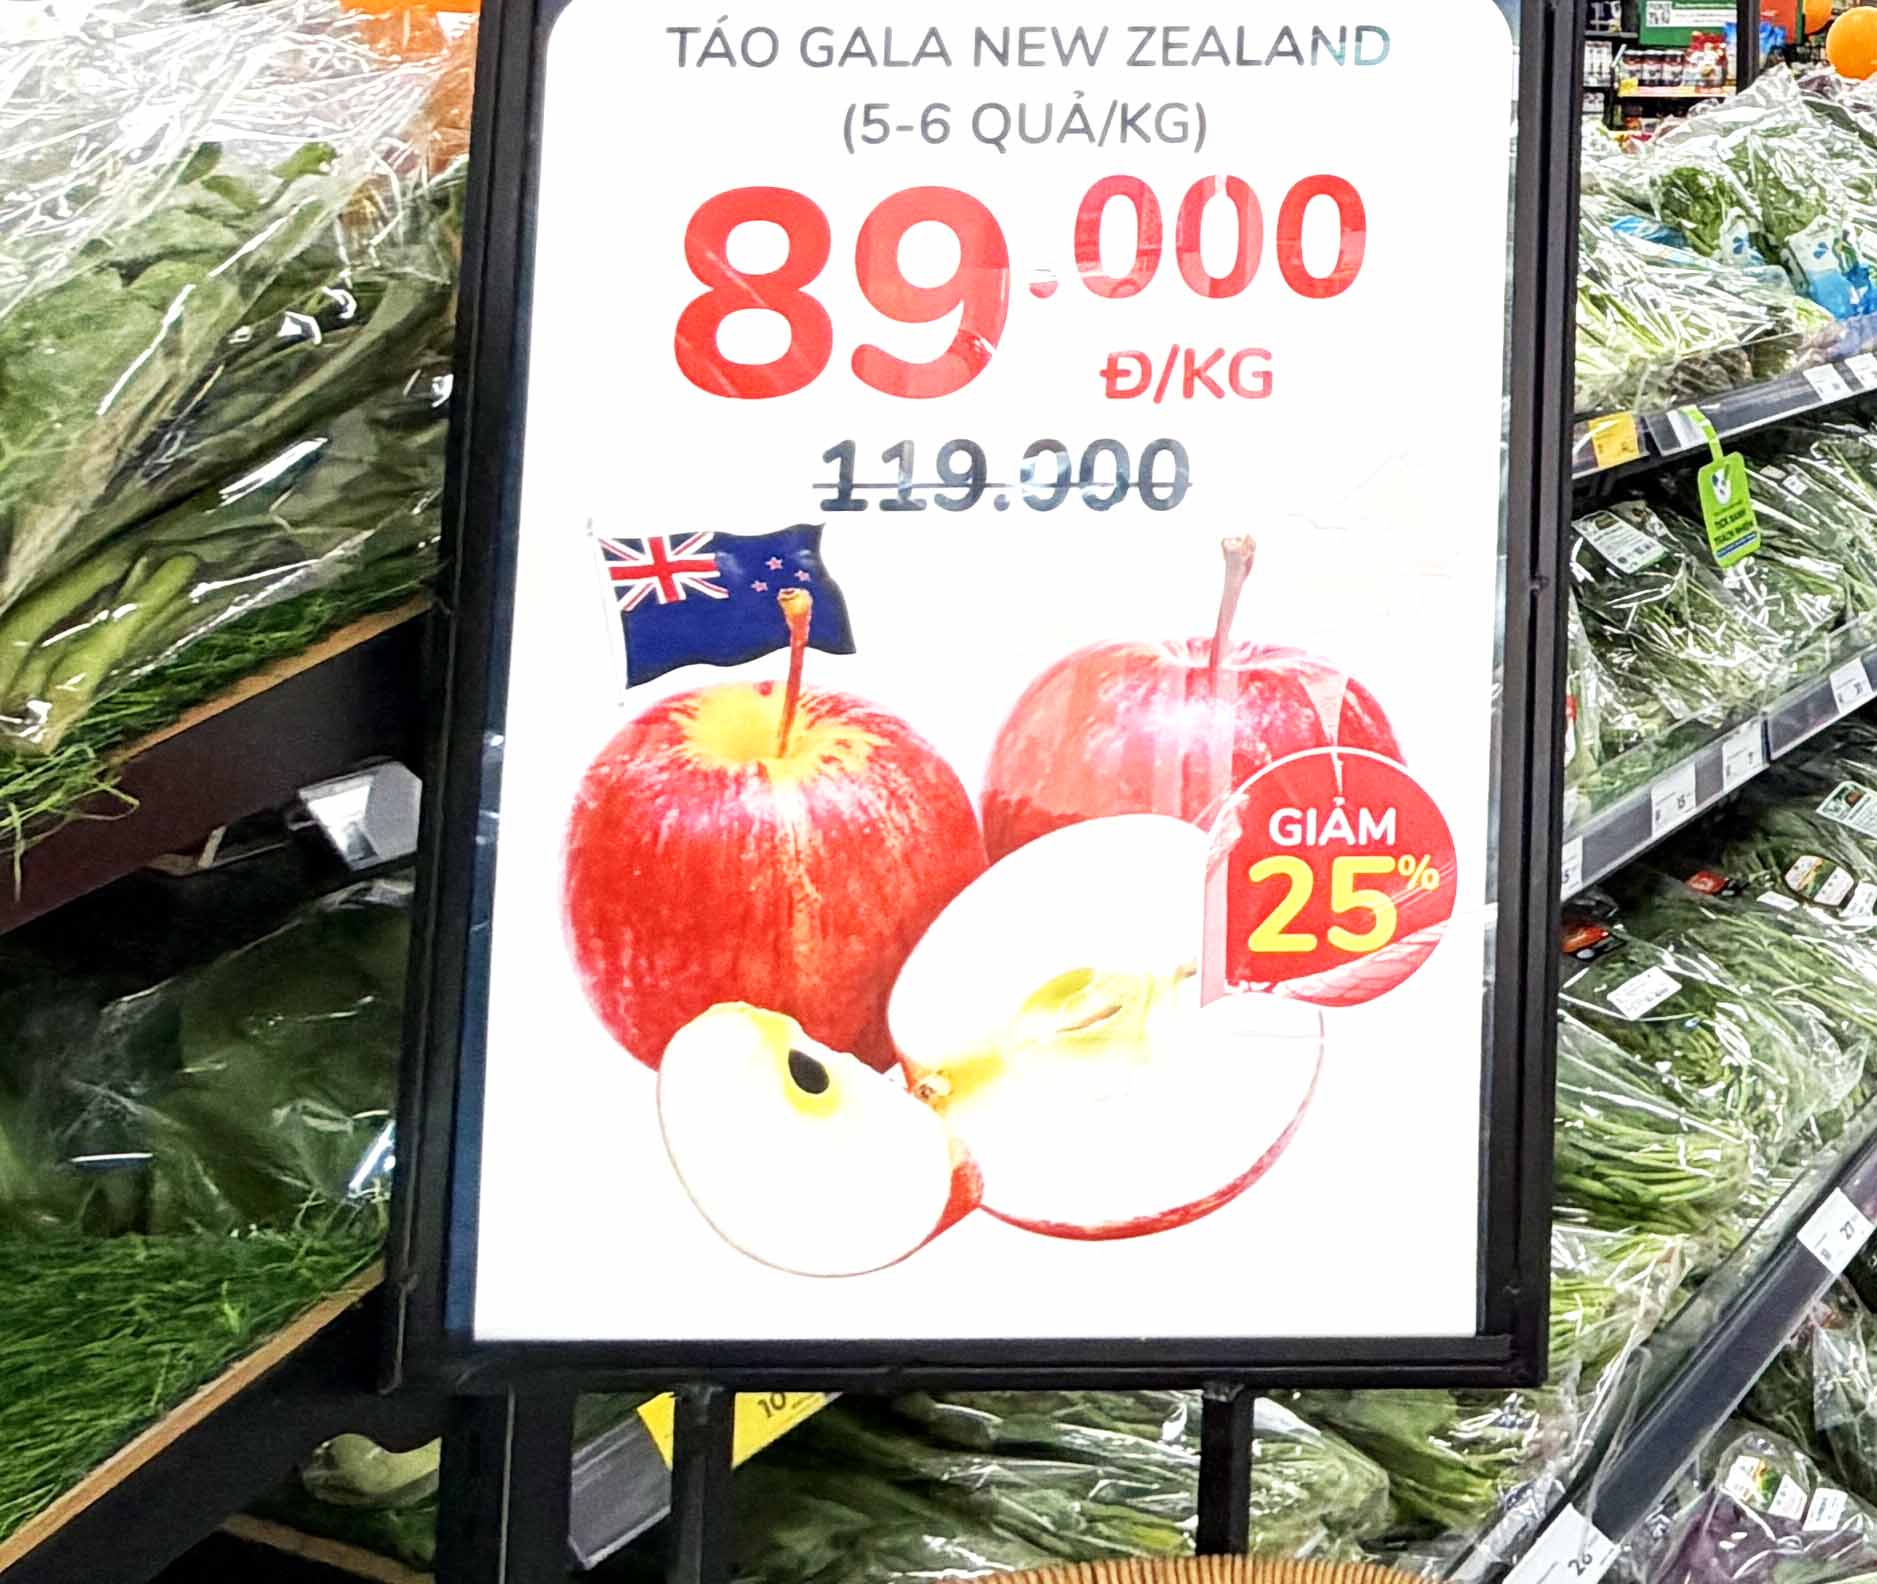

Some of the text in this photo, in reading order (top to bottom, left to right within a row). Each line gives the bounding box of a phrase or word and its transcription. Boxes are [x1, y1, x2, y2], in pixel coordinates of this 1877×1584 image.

[666, 14, 1393, 69] TÁO GALA NEW ZEALAND
[840, 89, 1209, 156] (5-6 QUẢ/KG)
[1099, 346, 1275, 403] Đ/KG
[811, 437, 1194, 514] 119.000
[1267, 793, 1398, 847] GIẢM
[1246, 854, 1440, 954] 25%
[1567, 1552, 1594, 1577] 26
